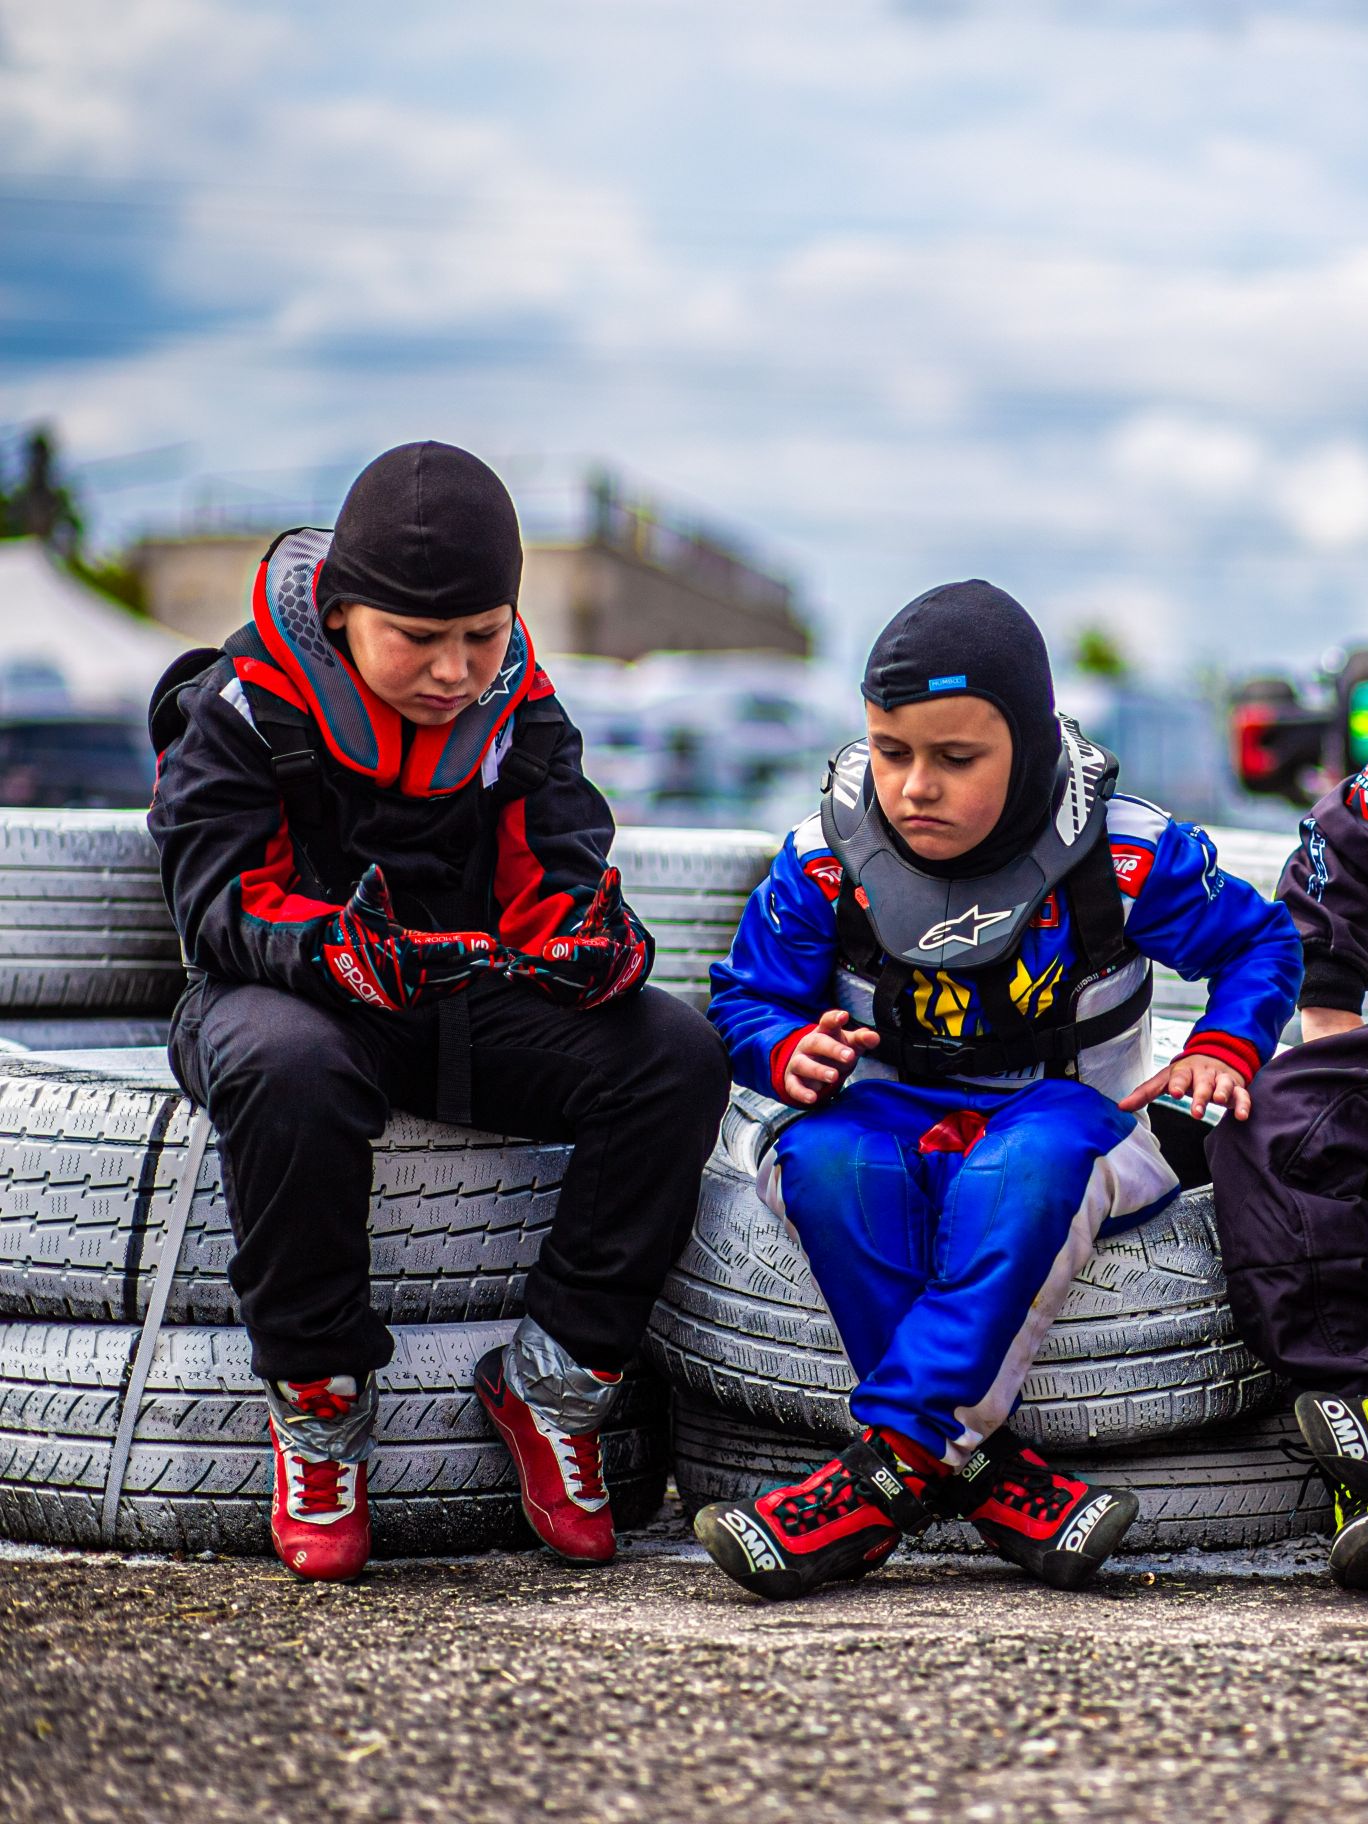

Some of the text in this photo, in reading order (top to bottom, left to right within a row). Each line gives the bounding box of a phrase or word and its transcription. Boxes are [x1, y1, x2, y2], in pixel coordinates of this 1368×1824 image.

[1322, 1400, 1365, 1460] OMP
[875, 1470, 900, 1496] OMP
[961, 1452, 985, 1479] OMP
[724, 1512, 776, 1571] OMP
[1065, 1494, 1113, 1551] OMP
